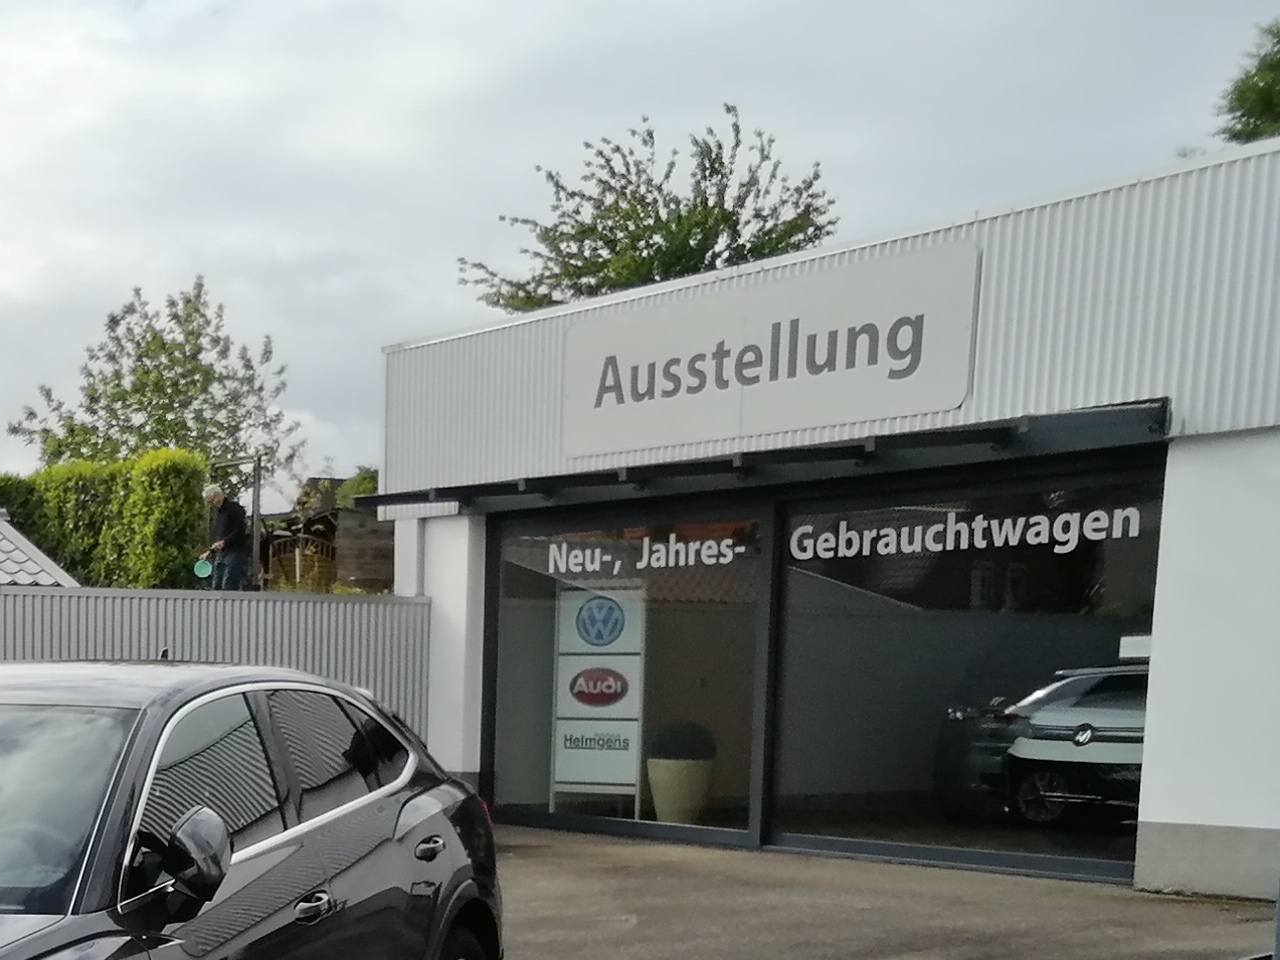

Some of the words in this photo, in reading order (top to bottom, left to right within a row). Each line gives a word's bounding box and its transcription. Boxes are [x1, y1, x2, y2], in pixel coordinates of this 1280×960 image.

[593, 313, 926, 409] Ausstellung
[548, 542, 622, 576] Neu-,
[635, 533, 746, 570] Jahres-
[789, 505, 1141, 561] Gebrauchtwagen
[576, 596, 625, 646] VW
[572, 676, 623, 695] Audi
